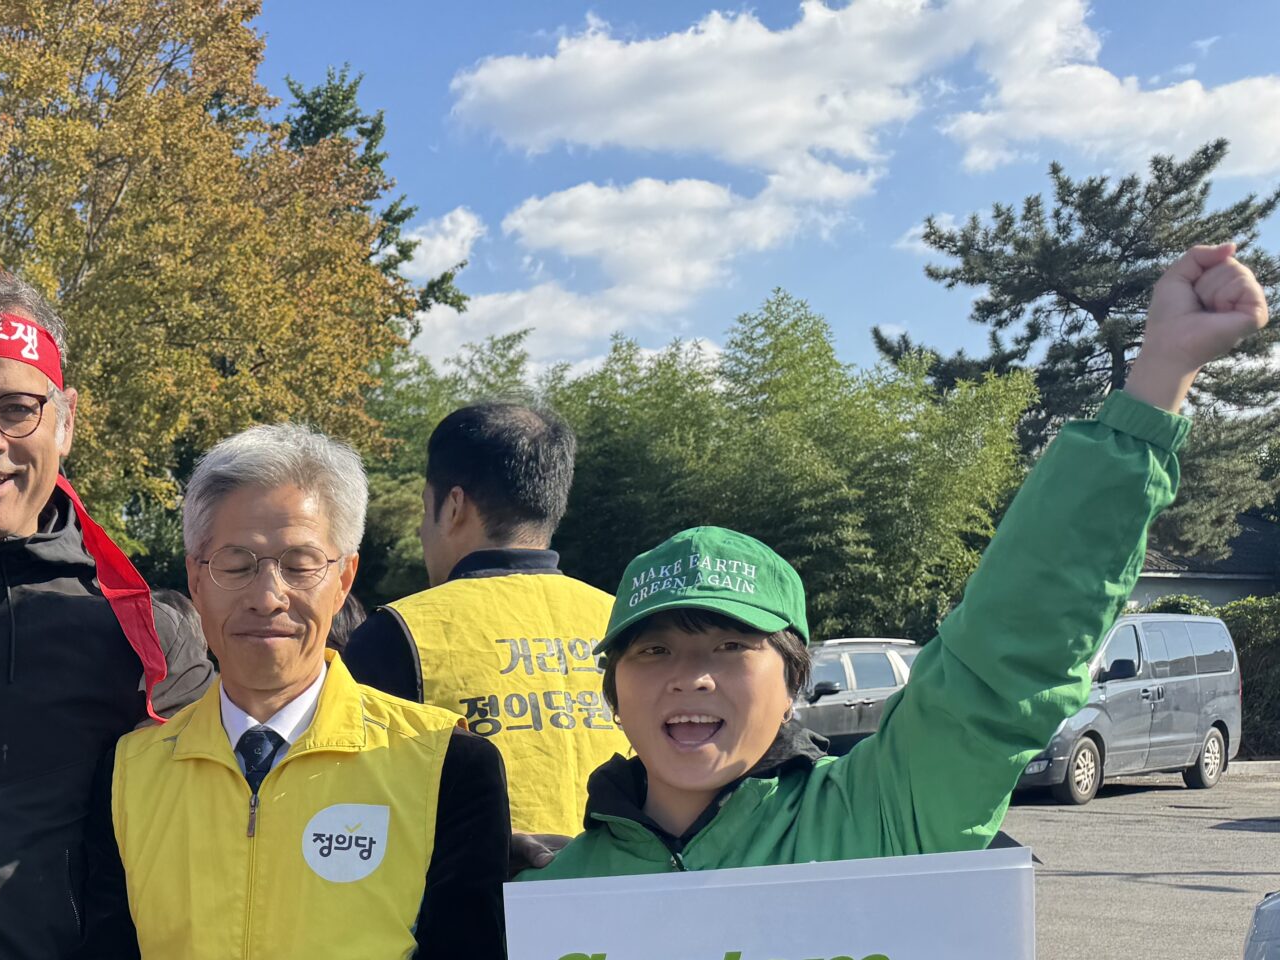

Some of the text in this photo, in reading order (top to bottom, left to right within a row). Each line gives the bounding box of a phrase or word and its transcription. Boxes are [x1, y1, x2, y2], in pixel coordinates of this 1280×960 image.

[628, 572, 756, 607] GREEN AGAIN
[631, 552, 757, 591] MAKE EARTH
[495, 637, 606, 675] 거리의
[312, 832, 377, 861] 정의당
